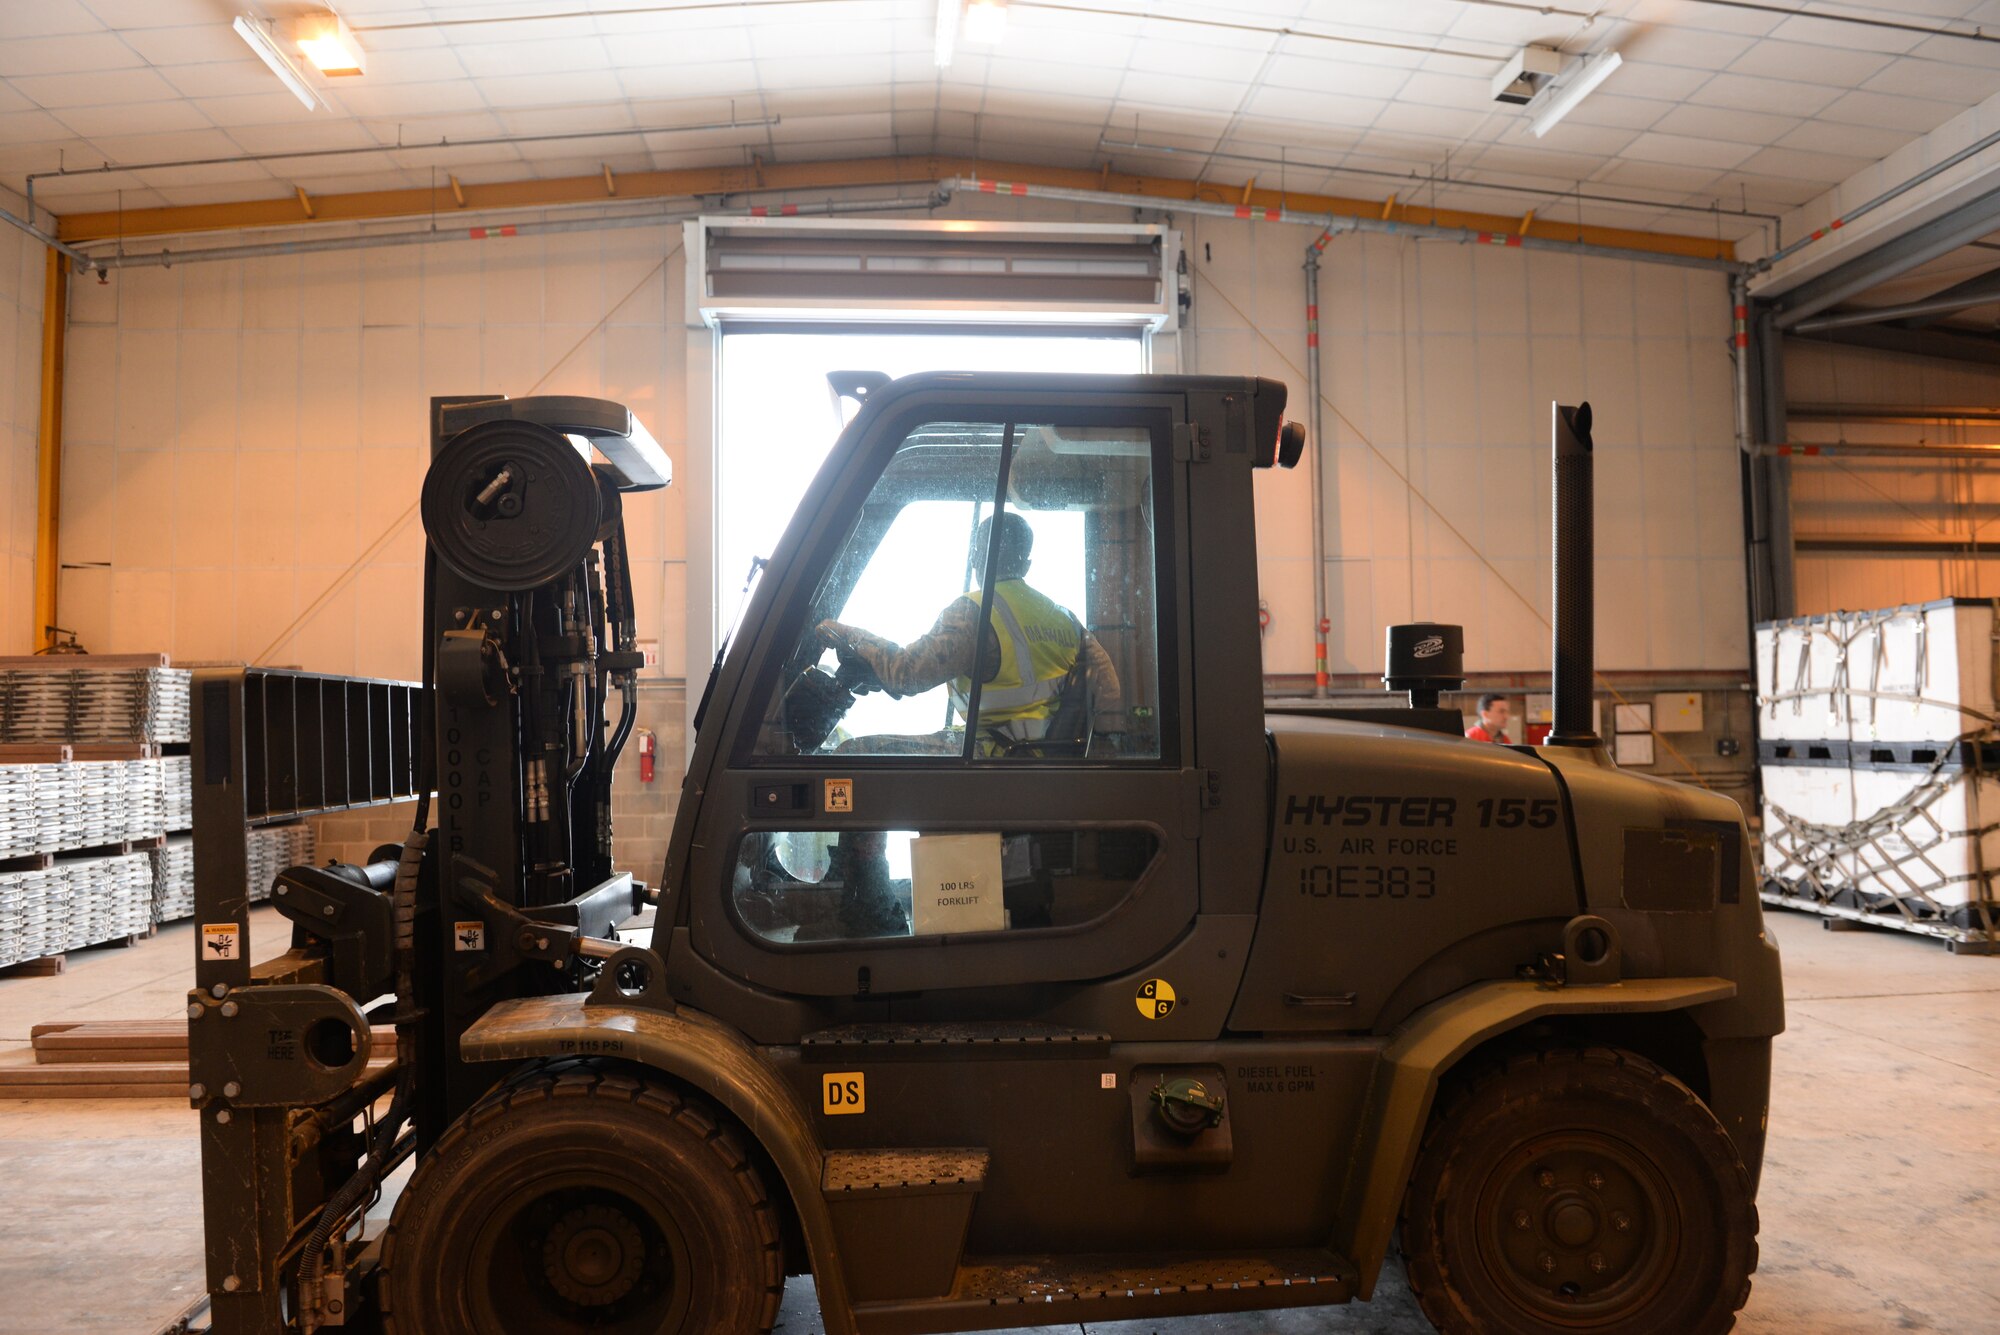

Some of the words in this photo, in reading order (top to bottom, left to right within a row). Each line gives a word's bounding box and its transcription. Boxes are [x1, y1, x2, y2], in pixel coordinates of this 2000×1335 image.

[475, 748, 492, 808] CAP
[1284, 795, 1457, 828] HYSTER
[1476, 798, 1558, 829] 155
[1283, 837, 1322, 855] U.S.
[1339, 838, 1375, 855] AIR
[1388, 839, 1458, 856] FORCE
[940, 882, 957, 891] 100
[958, 881, 975, 890] LRS
[1300, 866, 1436, 899] 10E383
[937, 896, 980, 907] FORKLIFT
[1144, 984, 1154, 996] C
[1157, 1002, 1168, 1014] G
[268, 1046, 294, 1060] HERE
[560, 1040, 575, 1052] TP
[579, 1040, 600, 1052] 115
[602, 1040, 624, 1052] PSI
[1238, 1066, 1281, 1079] DIESEL
[1285, 1065, 1317, 1078] FUEL
[828, 1080, 860, 1106] DS
[1247, 1082, 1273, 1093] MAX
[1287, 1080, 1316, 1092] GPM
